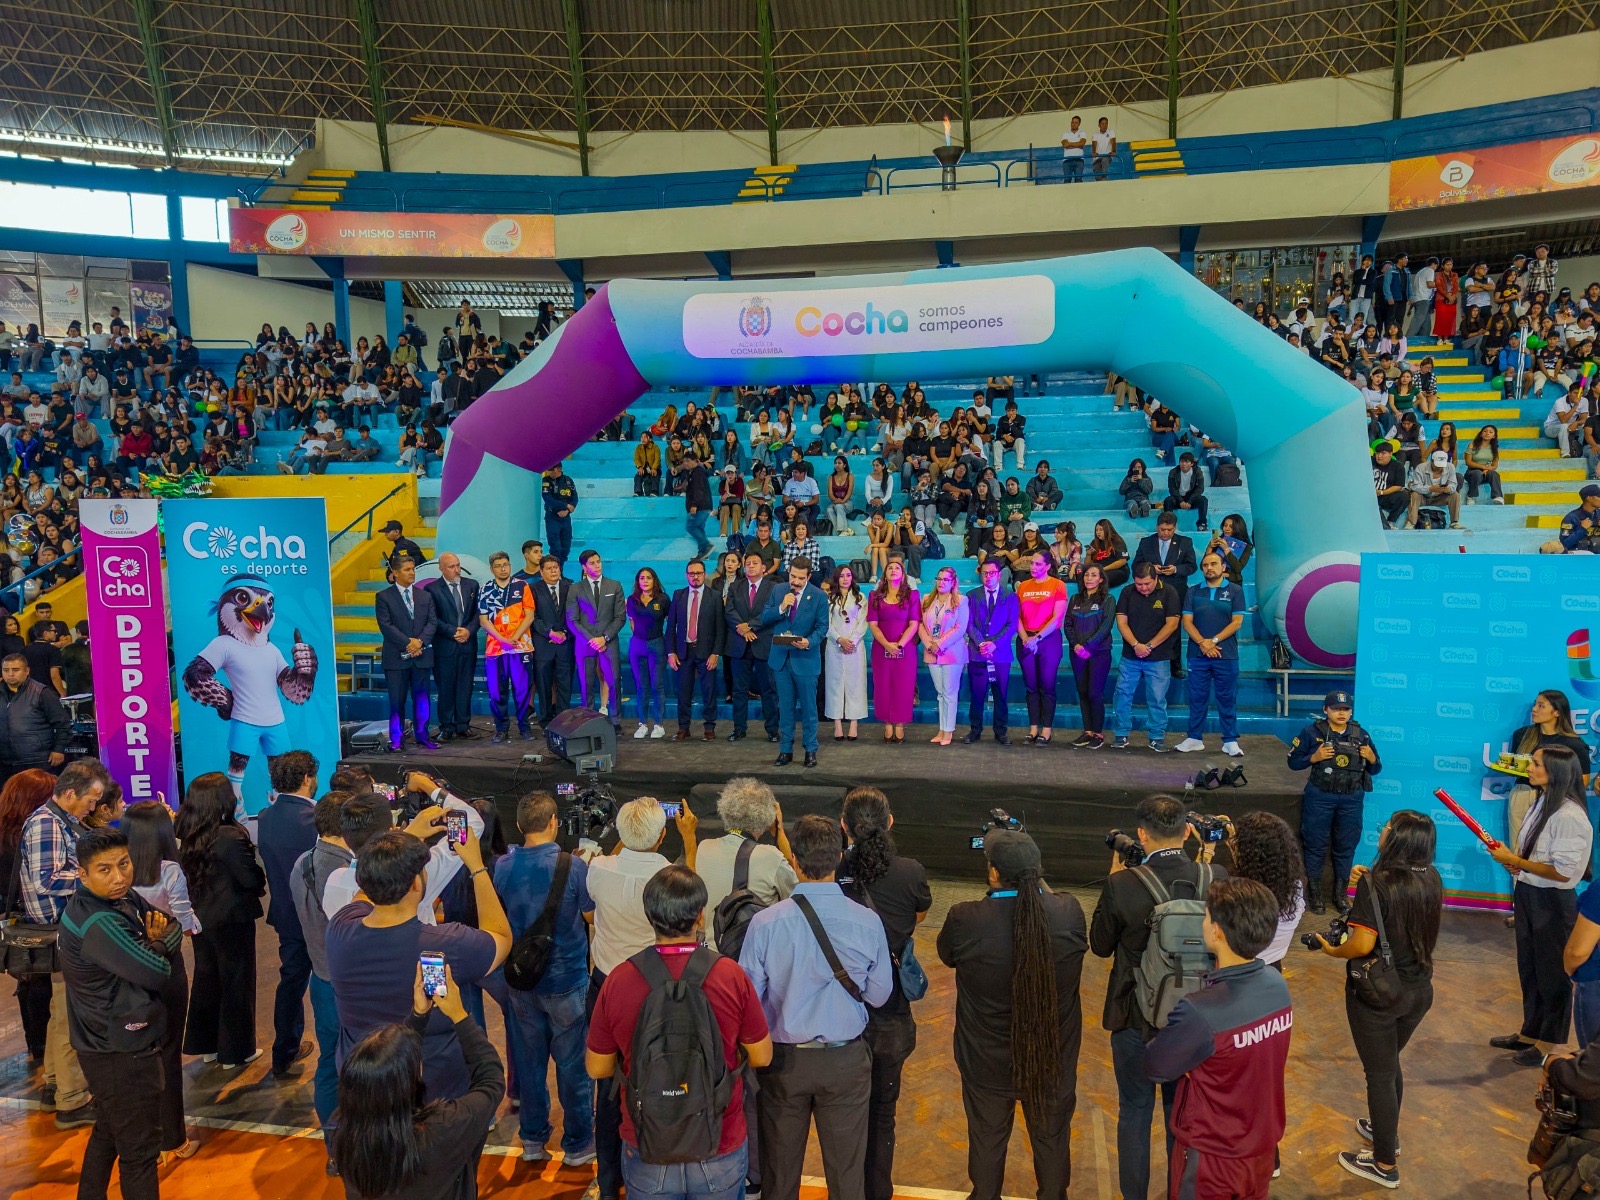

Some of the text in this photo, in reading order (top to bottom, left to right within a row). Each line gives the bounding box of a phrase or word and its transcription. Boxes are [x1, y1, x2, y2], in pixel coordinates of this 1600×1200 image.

[1553, 167, 1585, 176] COCHA
[339, 229, 436, 239] UN MISMO SENTIR
[919, 305, 966, 318] somos
[795, 301, 909, 338] Cocha
[919, 317, 1004, 334] campeones
[730, 347, 784, 355] COCHABAMBA
[182, 521, 306, 559] Cocha
[220, 561, 308, 578] es deporte
[1380, 567, 1411, 577] Cocha
[1495, 568, 1528, 579] Cocha
[1446, 596, 1477, 606] Cocha
[1564, 598, 1597, 609] Cocha
[1377, 621, 1408, 631] Cocha
[1491, 624, 1524, 635] Cocha
[1443, 650, 1475, 661] Cocha
[1374, 675, 1405, 686] Cocha
[1488, 679, 1521, 690] Cocha
[115, 614, 152, 798] DEPORTE
[1439, 705, 1471, 717] Cocha
[1437, 759, 1468, 771] Cocha
[1373, 782, 1399, 792] ocha
[1160, 849, 1181, 858] SONY
[1440, 867, 1462, 877] ocha
[1233, 1010, 1293, 1049] UNIVALL
